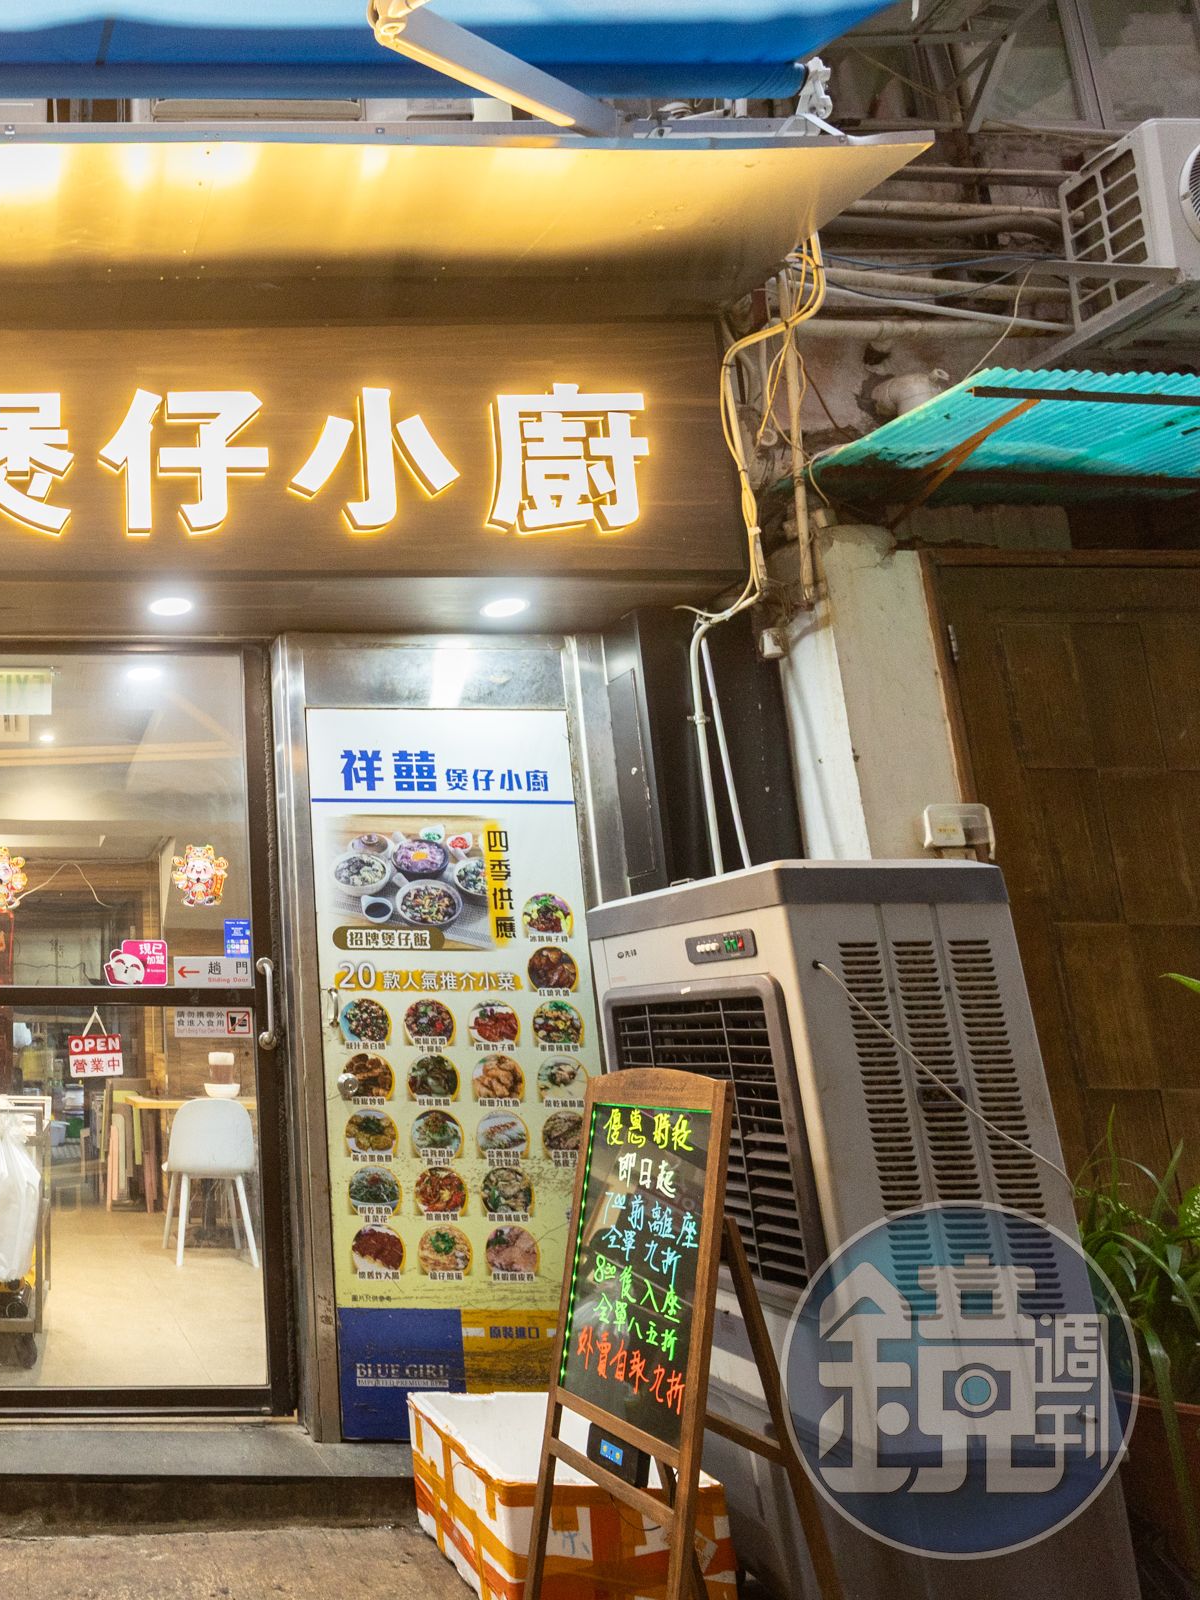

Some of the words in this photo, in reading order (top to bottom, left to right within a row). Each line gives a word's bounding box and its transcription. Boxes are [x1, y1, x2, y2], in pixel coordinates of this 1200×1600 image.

[340, 749, 438, 792] 祥囍
[445, 768, 550, 792] 煲仔小廚
[486, 830, 517, 939] 四季供應
[139, 943, 163, 955] 現已
[346, 930, 431, 949] 招牌煲仔飯
[338, 962, 376, 989] 20
[383, 972, 516, 991] 款人氣推介小菜
[70, 1037, 120, 1052] OPEN
[73, 1056, 121, 1074] 營業中
[618, 1152, 676, 1198] 即日起
[355, 1363, 402, 1378] BLUE
